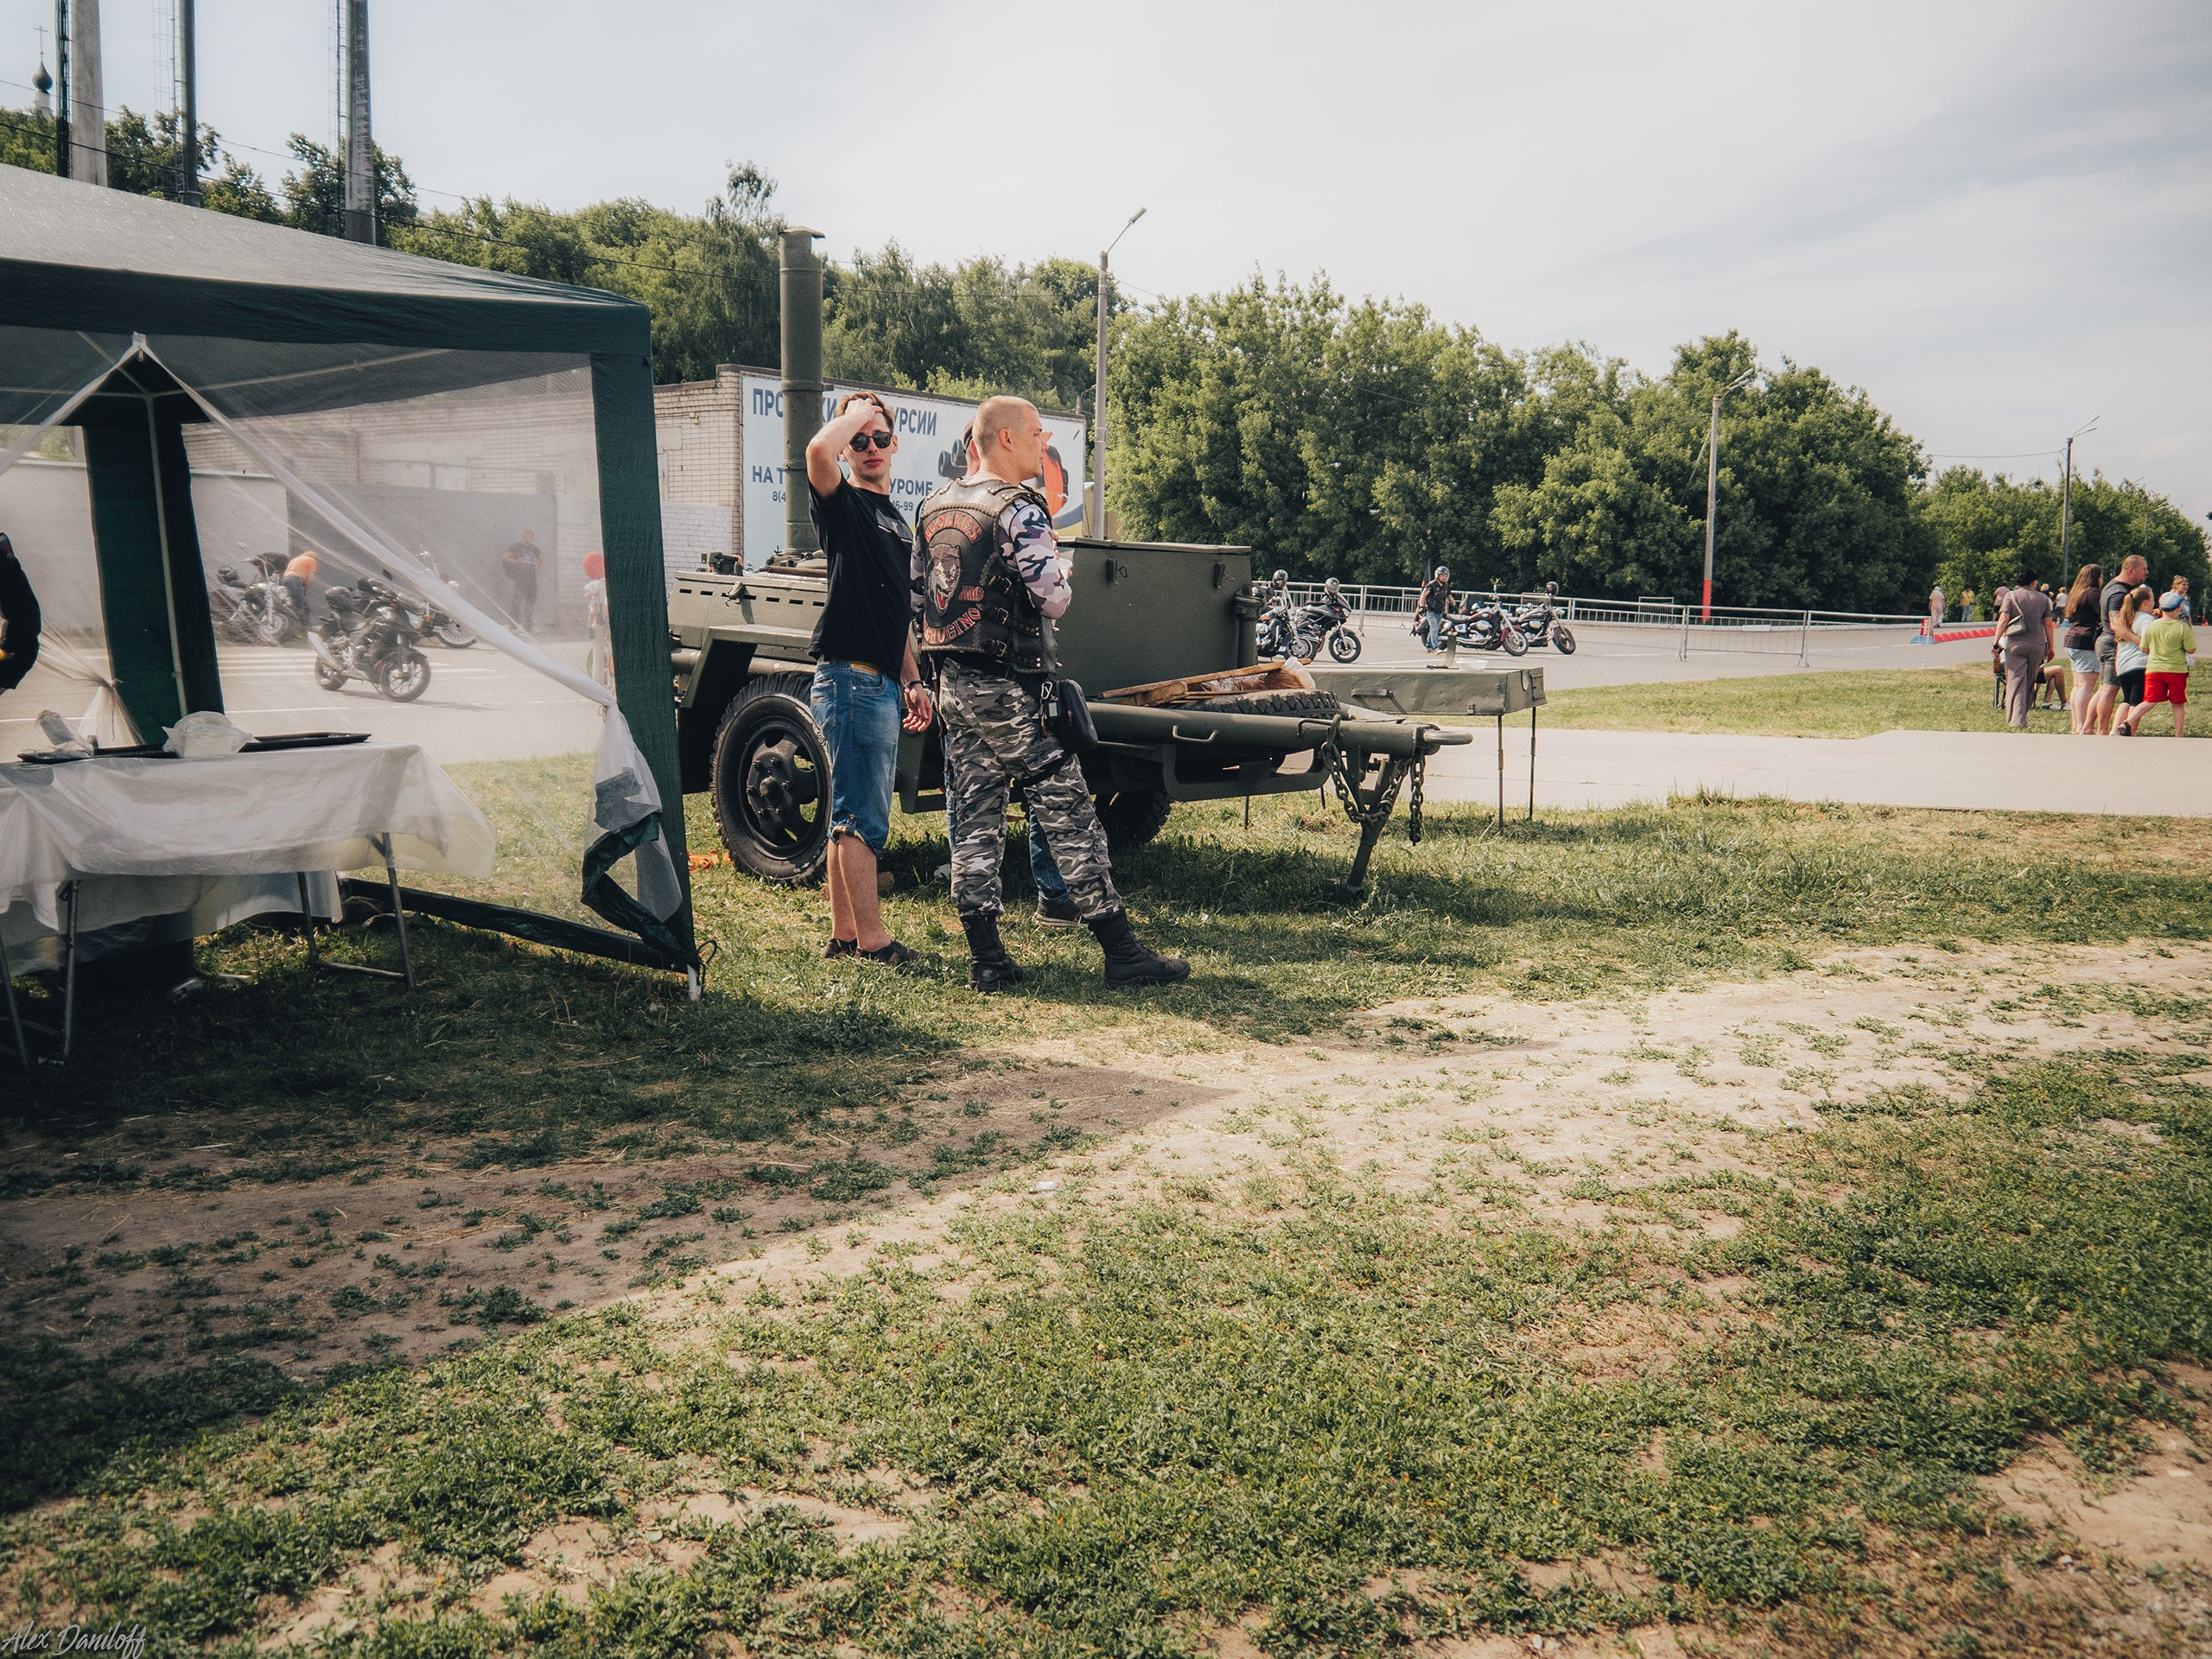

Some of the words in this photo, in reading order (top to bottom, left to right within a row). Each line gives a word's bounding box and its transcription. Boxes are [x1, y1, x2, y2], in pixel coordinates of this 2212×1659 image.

[752, 465, 773, 484] НА
[889, 478, 933, 496] УРОМЕ
[958, 585, 985, 601] MC
